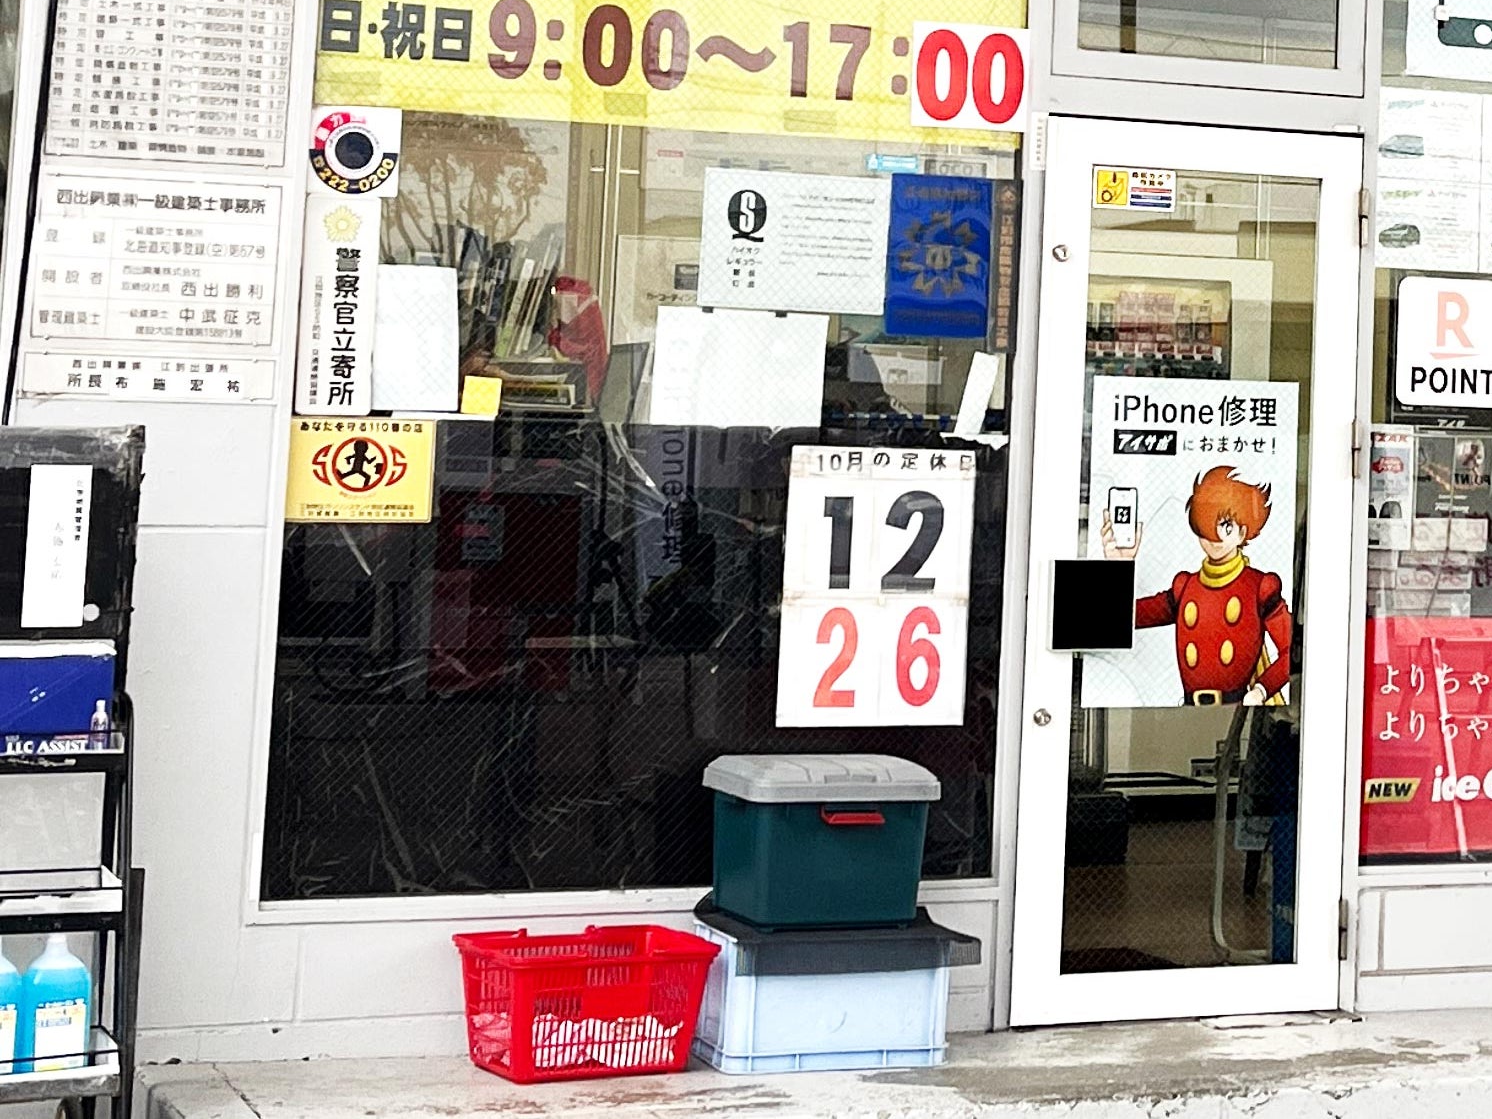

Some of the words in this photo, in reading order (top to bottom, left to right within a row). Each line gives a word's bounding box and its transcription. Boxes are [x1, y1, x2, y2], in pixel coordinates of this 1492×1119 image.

[326, 247, 361, 407] 警察官立寄所
[1436, 290, 1474, 348] R
[816, 451, 975, 473] 10月の定休日
[823, 490, 945, 590] 12
[812, 605, 942, 708] 26
[1368, 782, 1413, 799] NEW
